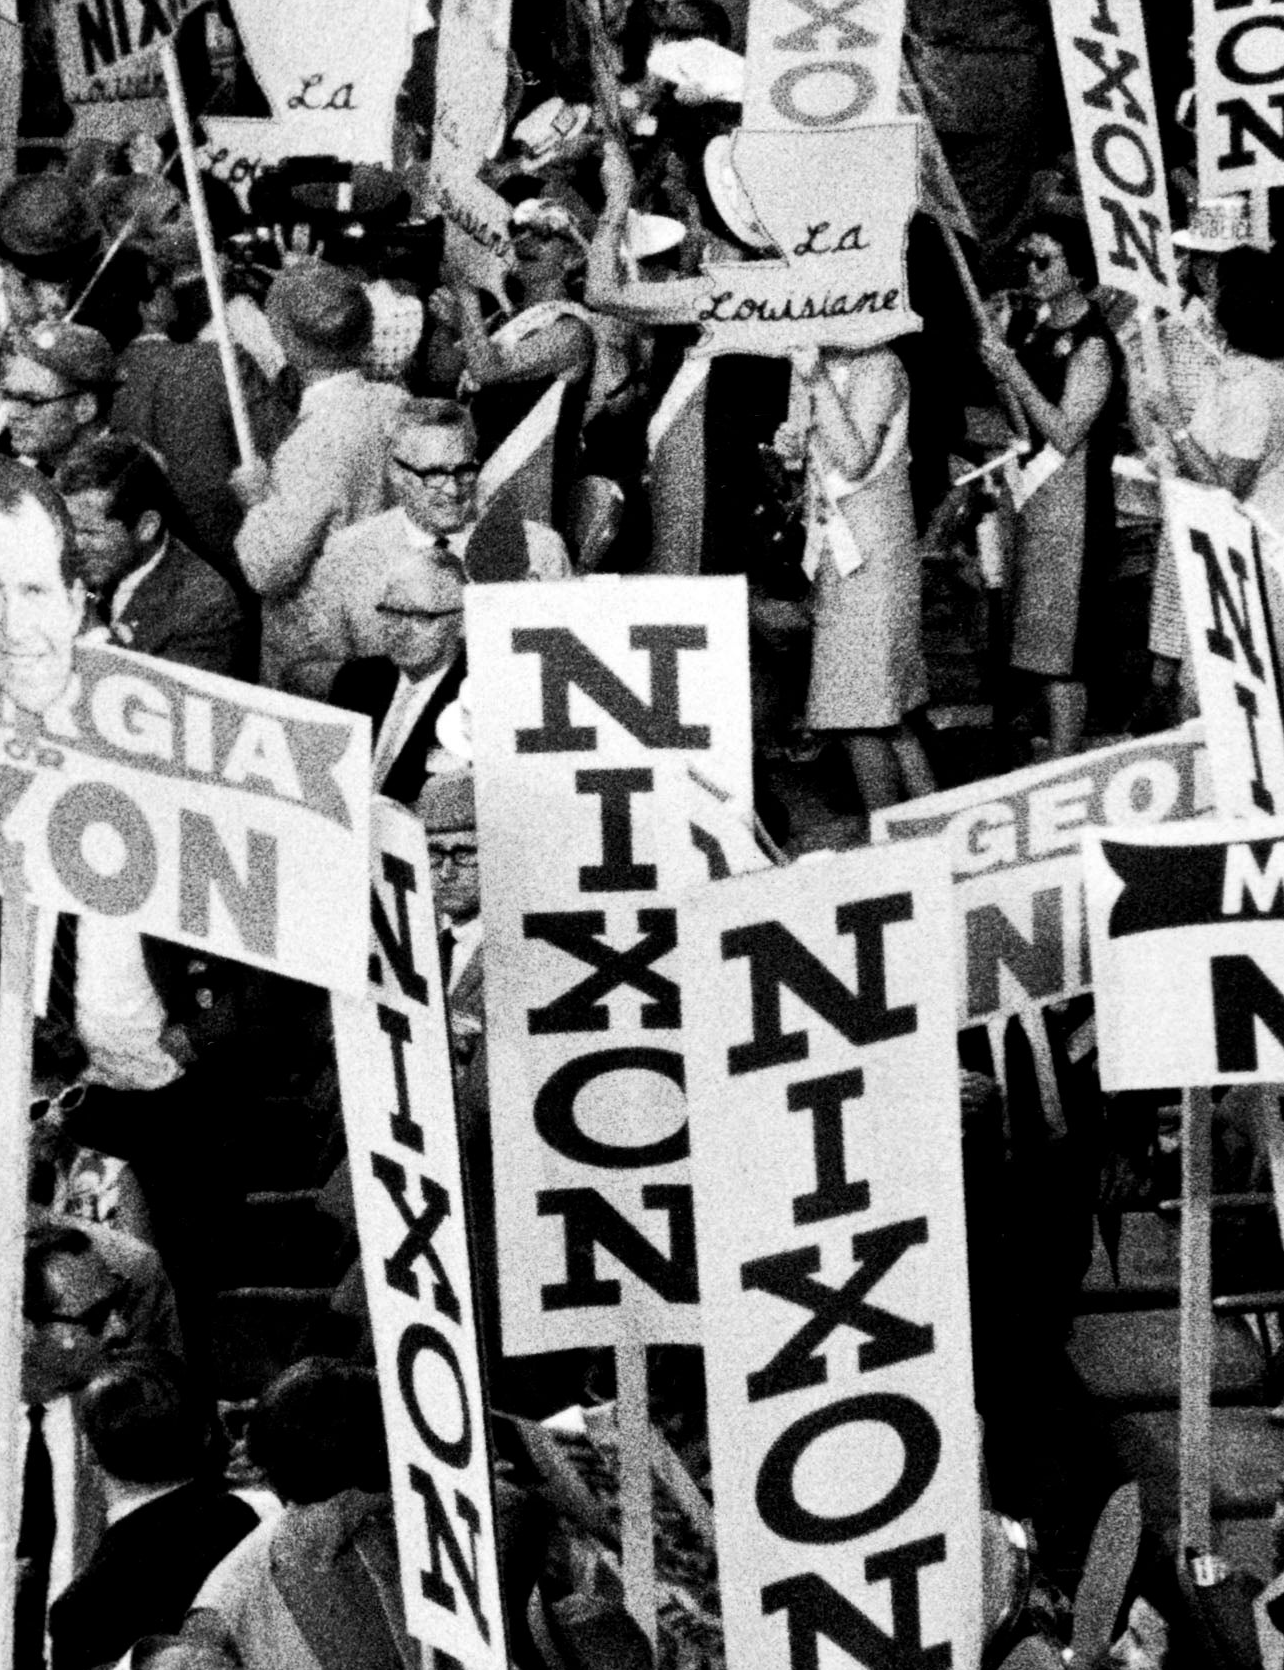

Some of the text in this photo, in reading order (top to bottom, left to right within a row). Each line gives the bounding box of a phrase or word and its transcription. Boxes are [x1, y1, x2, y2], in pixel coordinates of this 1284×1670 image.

[699, 282, 905, 327] Louisiane
[369, 849, 499, 1656] NIXON
[510, 623, 712, 1309] NIXON
